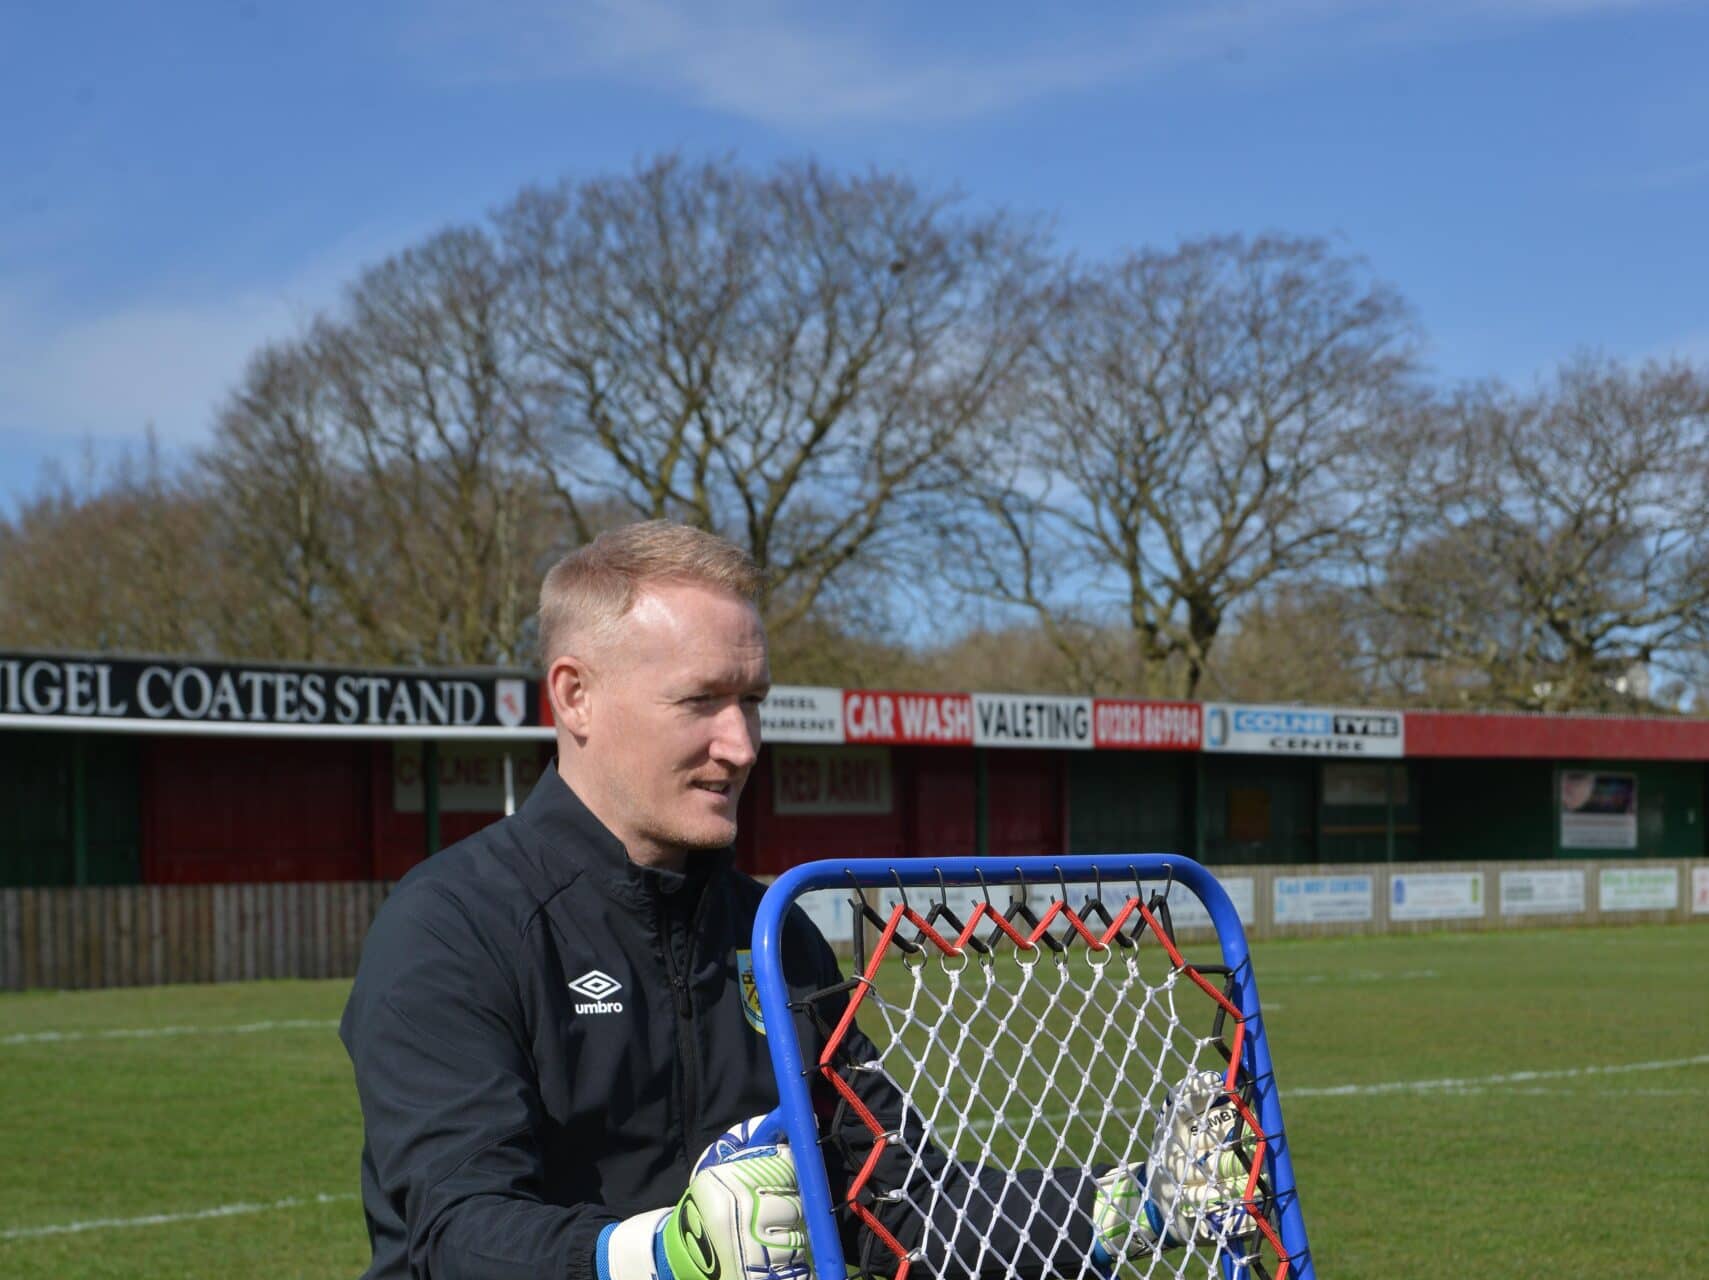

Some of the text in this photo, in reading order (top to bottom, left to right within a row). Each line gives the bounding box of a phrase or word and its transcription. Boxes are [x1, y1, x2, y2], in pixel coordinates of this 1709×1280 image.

[0, 661, 483, 726] IGEL COATES STAND
[849, 694, 972, 740] CAR WASH
[977, 700, 1088, 741] VALETING
[1238, 712, 1397, 736] COLNE TYRE
[1269, 737, 1364, 751] CENTRE
[575, 1000, 623, 1014] umbro
[1191, 1107, 1240, 1137] SMBA
